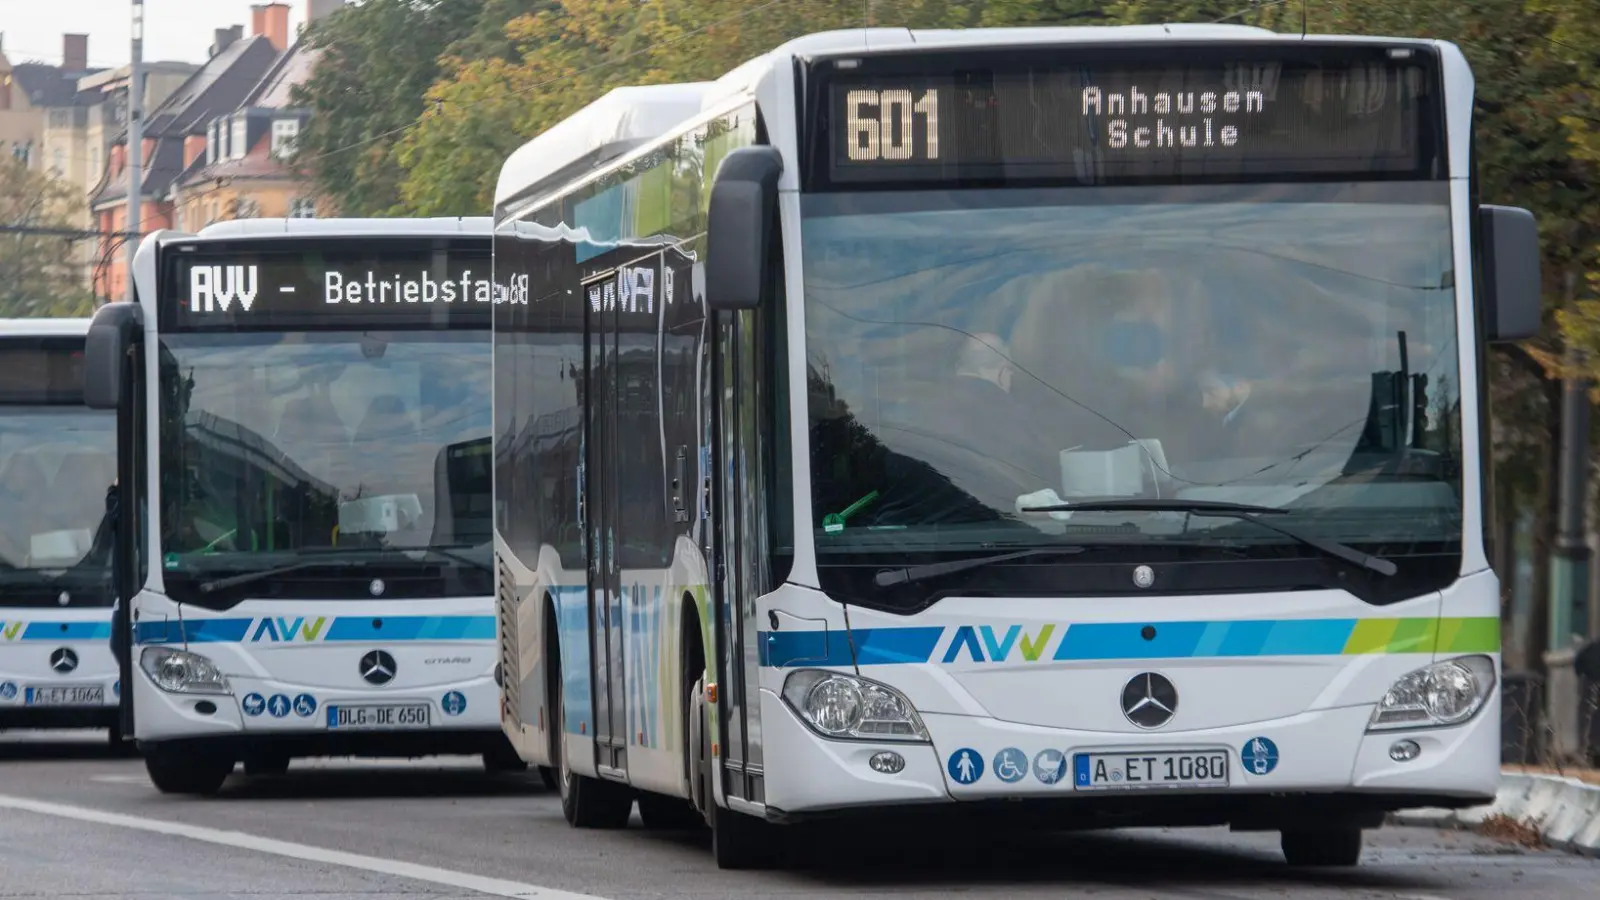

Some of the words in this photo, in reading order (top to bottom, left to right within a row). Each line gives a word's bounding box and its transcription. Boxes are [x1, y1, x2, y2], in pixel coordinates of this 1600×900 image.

[847, 88, 938, 161] 601
[1082, 85, 1264, 116] Anhausen
[1108, 117, 1238, 148] Schule
[190, 265, 258, 312] AVV
[339, 708, 367, 725] DLG
[377, 708, 394, 725] DE
[398, 707, 425, 724] 650
[1093, 758, 1109, 782] A
[1125, 757, 1157, 781] ET
[1163, 755, 1225, 781] 1080
